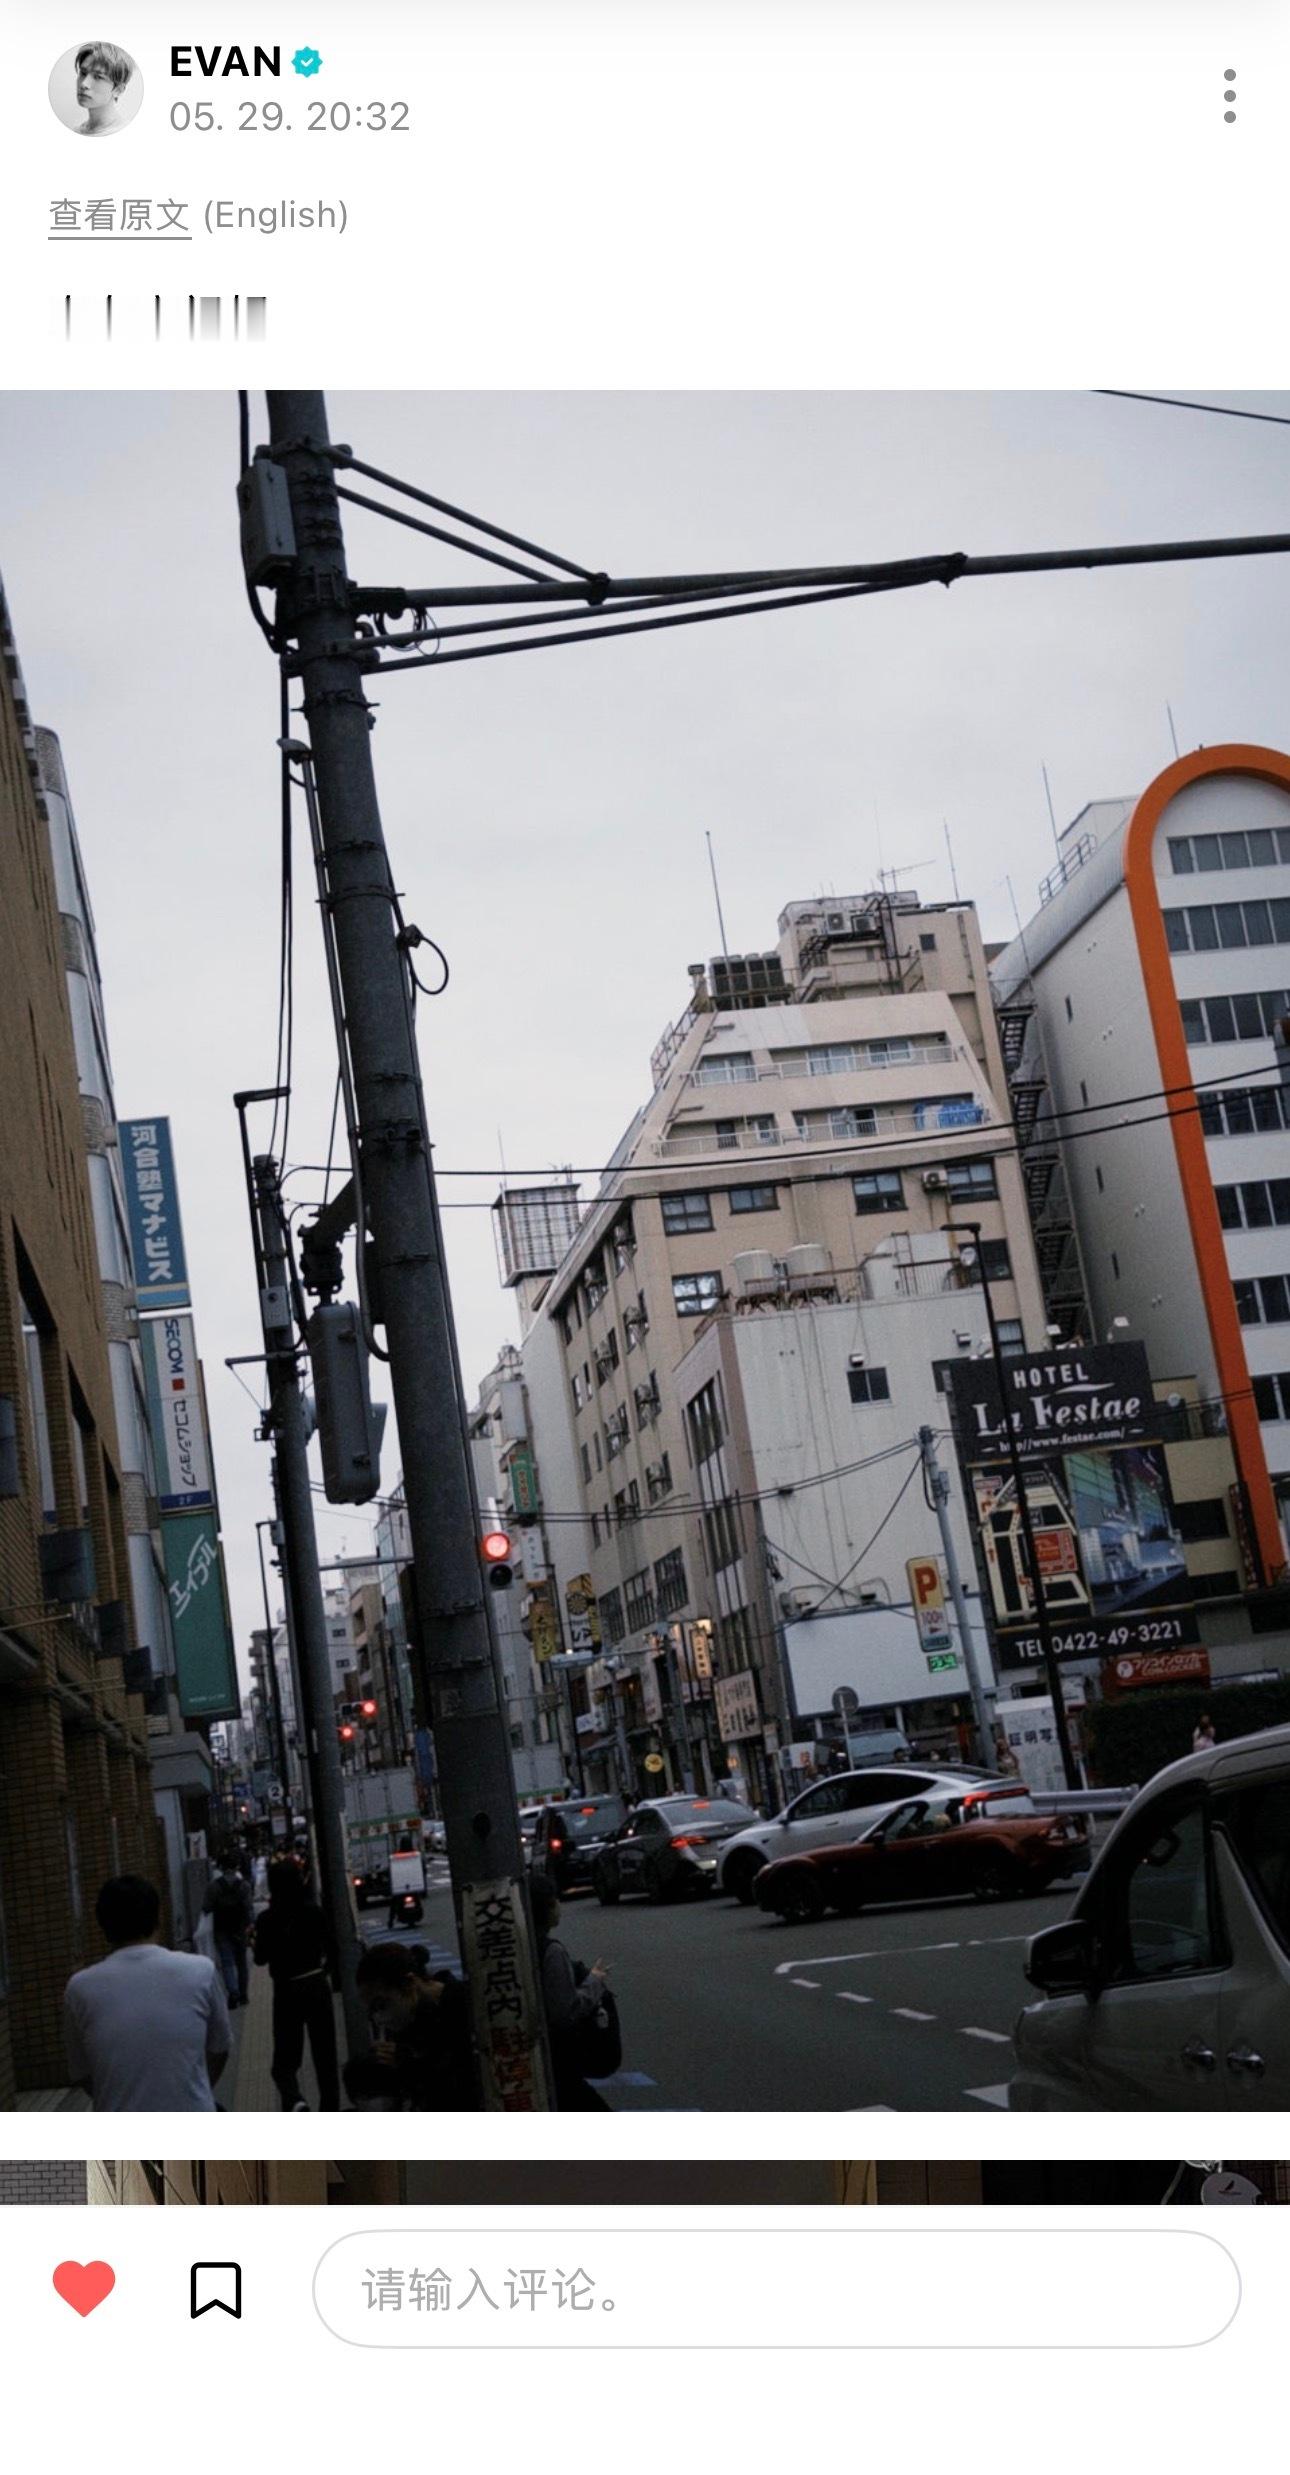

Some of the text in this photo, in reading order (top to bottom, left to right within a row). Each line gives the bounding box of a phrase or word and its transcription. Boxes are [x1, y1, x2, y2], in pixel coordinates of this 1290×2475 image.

[131, 1125, 173, 1282] 河合塾マナビス
[164, 1318, 185, 1374] SECOM
[1013, 1363, 1089, 1389] HOTEL
[1030, 1394, 1141, 1429] Festae
[173, 1397, 198, 1488] セコムショップ
[169, 1541, 217, 1607] エイブル
[914, 1566, 938, 1605] P
[1015, 1620, 1183, 1659] TEL 0422-49-3221
[1009, 1727, 1052, 1746] 証明写
